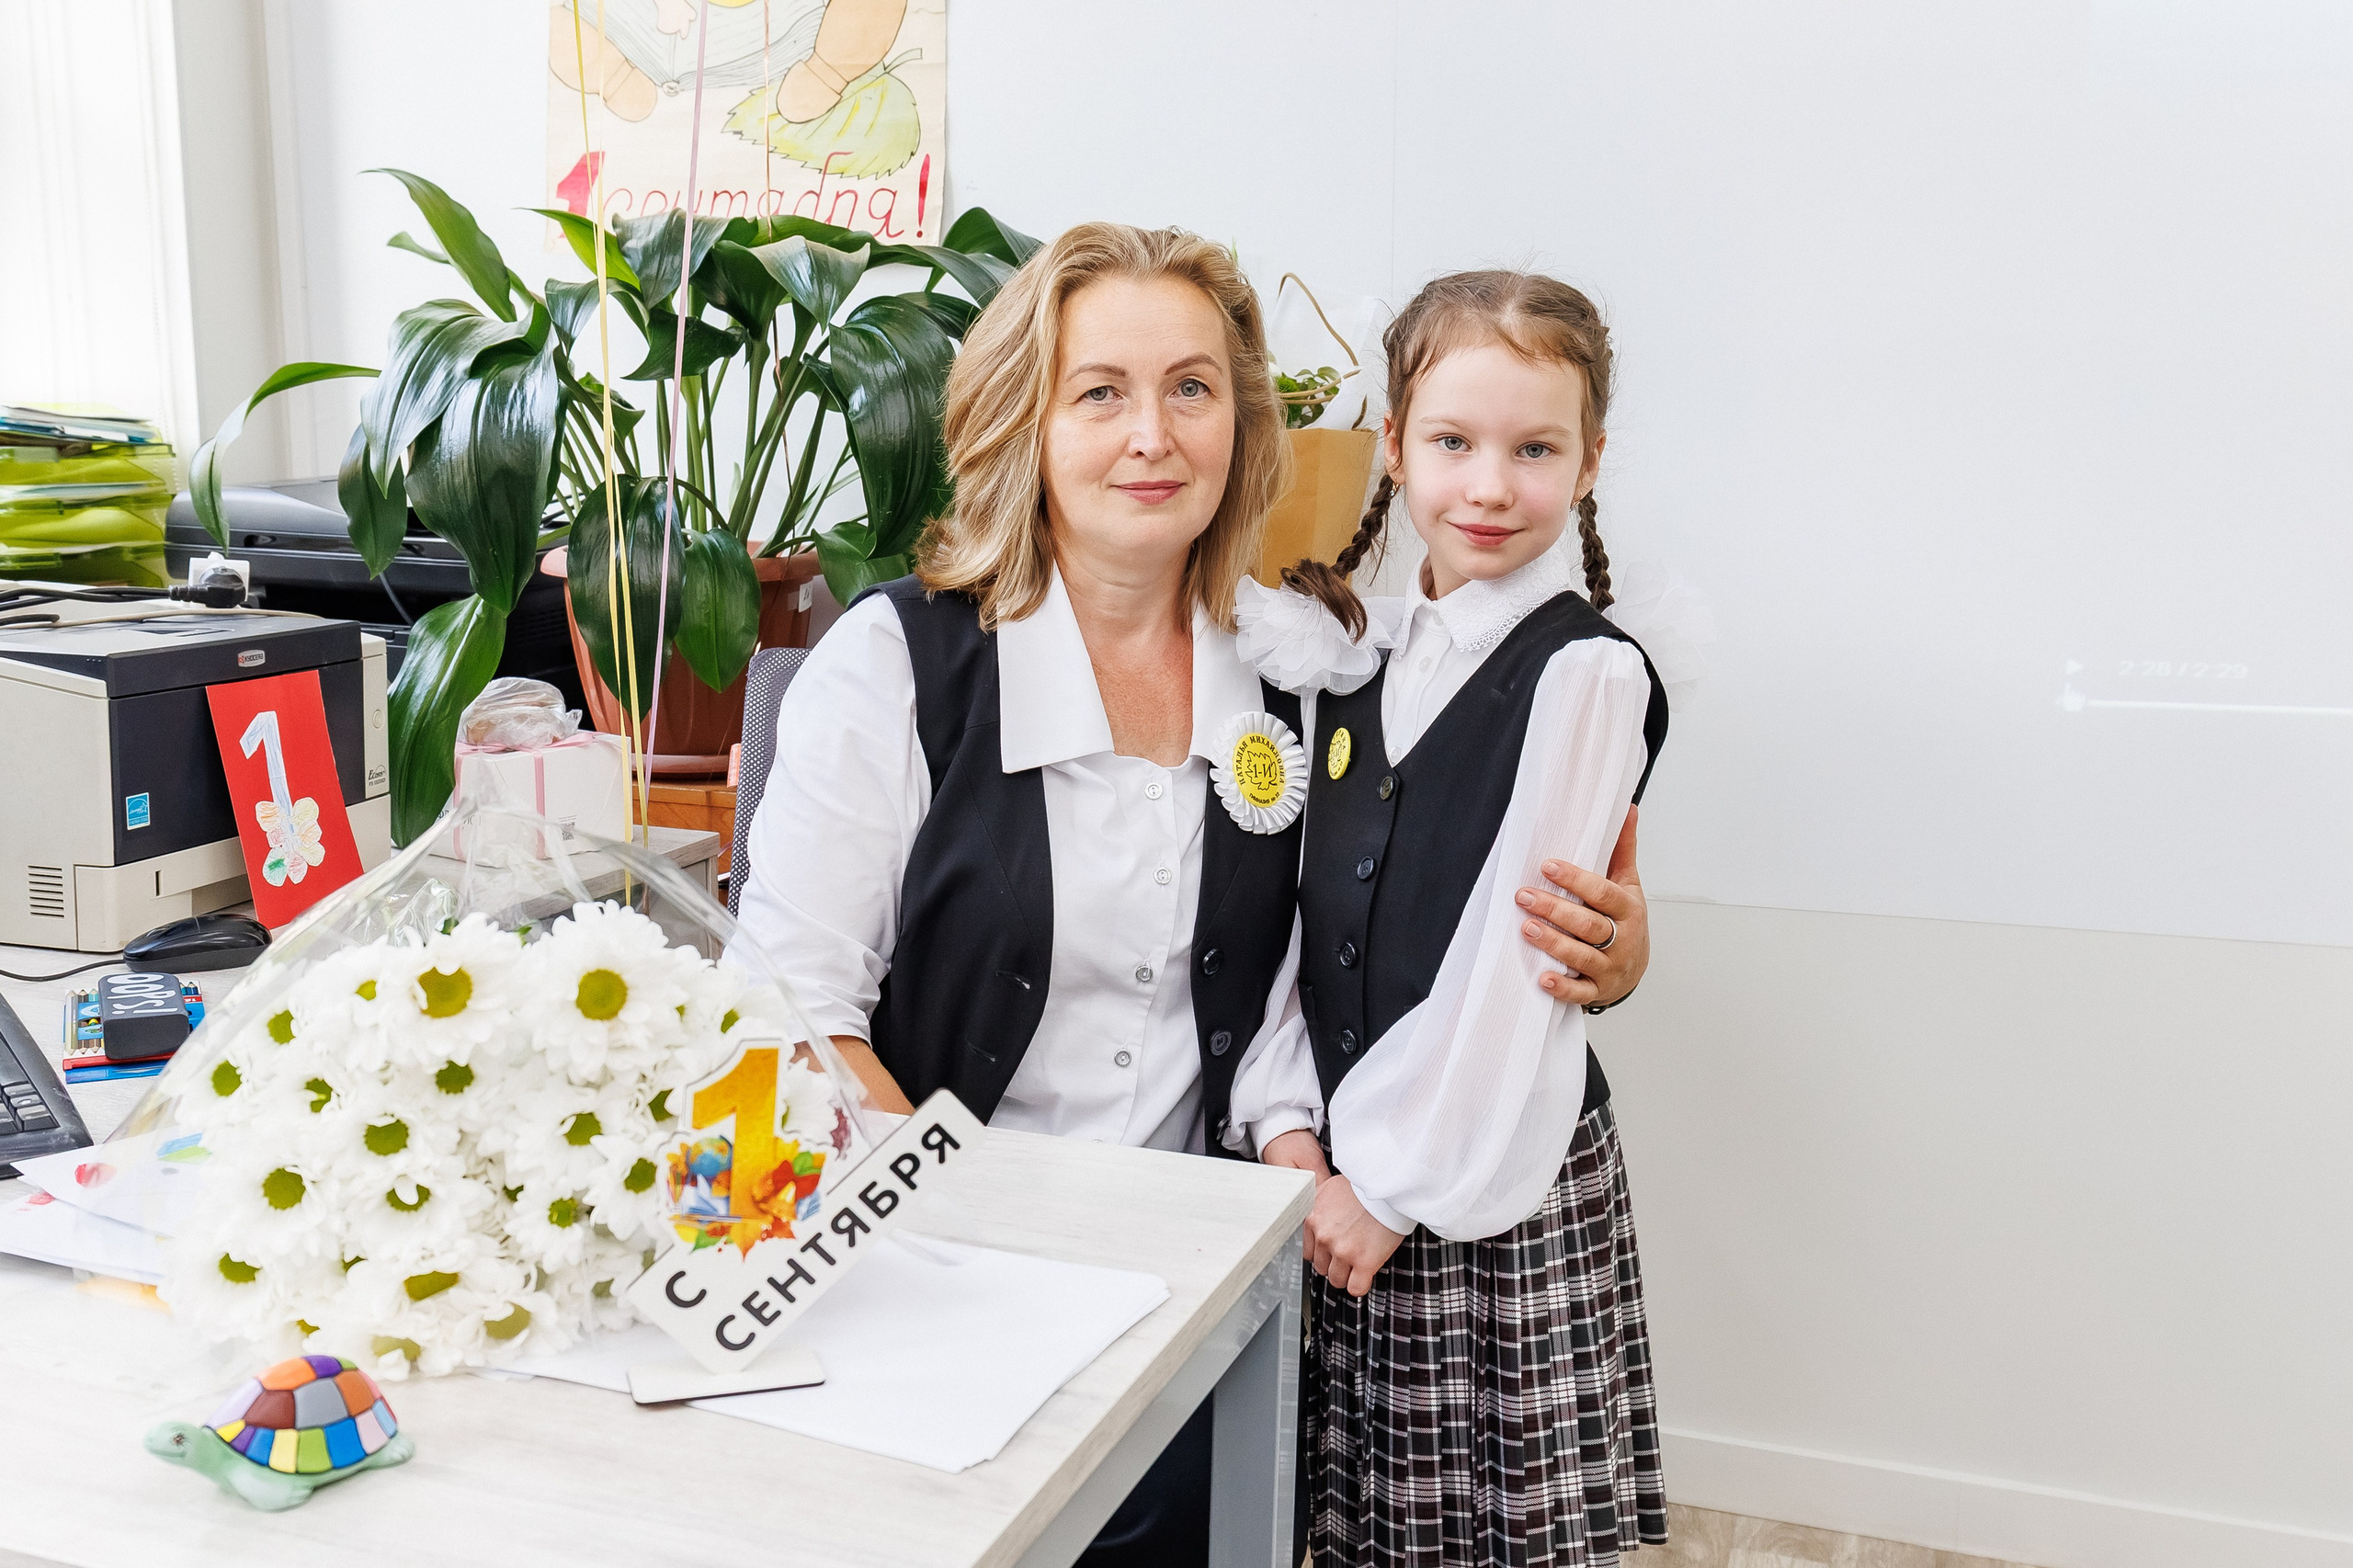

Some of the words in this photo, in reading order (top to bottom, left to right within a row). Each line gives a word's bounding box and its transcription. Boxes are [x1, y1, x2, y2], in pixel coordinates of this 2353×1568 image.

[556, 151, 606, 238] 1
[244, 653, 264, 662] KYOCERA
[239, 710, 295, 833] 1
[1235, 741, 1248, 786] НАТАЛЬЯ
[1253, 763, 1272, 778] 1-И
[665, 1270, 707, 1308] С
[691, 1048, 779, 1222] 1
[715, 1122, 961, 1351] СЕНТЯБРЯ
